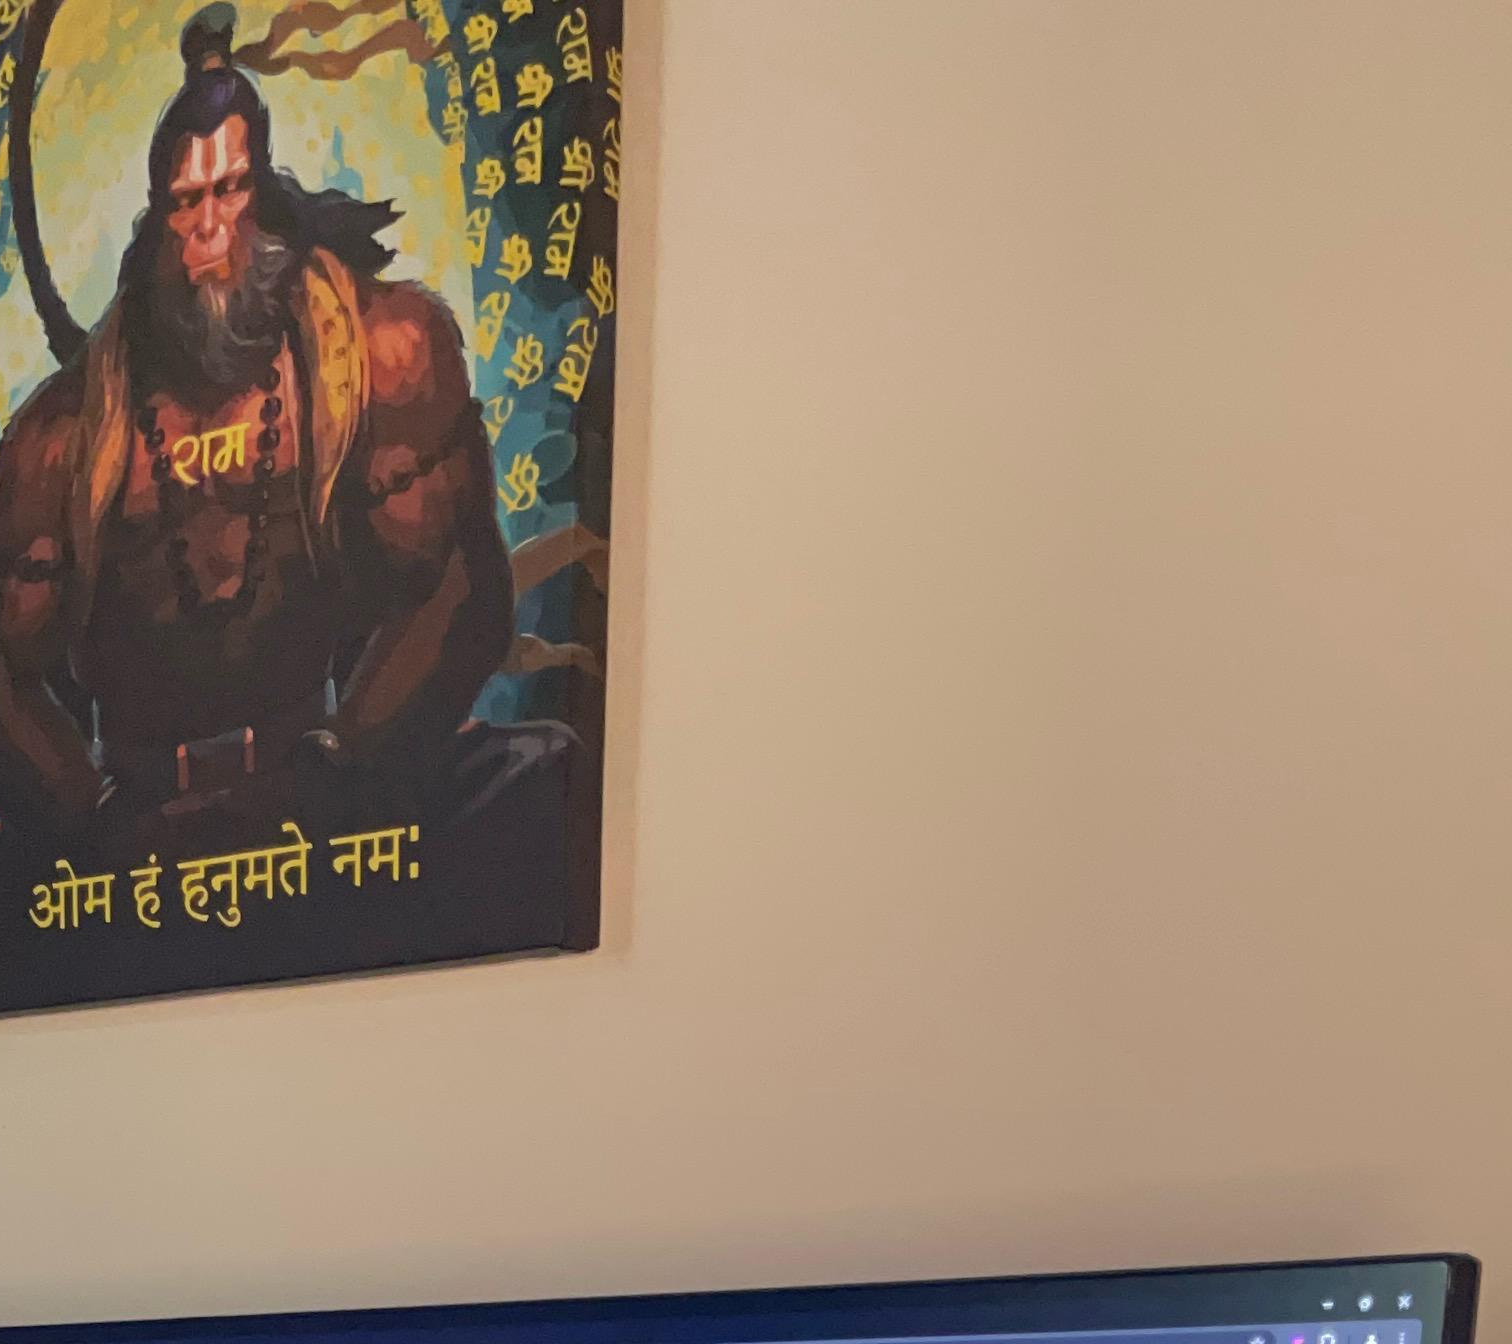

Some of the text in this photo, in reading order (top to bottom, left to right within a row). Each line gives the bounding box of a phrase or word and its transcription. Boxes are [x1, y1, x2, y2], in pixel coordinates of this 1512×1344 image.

[516, 63, 553, 109] श्री
[513, 116, 543, 184] राम
[504, 7, 594, 390] राम श्री राम श्री
[495, 233, 532, 284] श्री
[586, 256, 614, 318] श्री
[554, 317, 598, 402] राम
[172, 422, 251, 486] राम
[498, 453, 540, 515] श्री
[29, 860, 114, 929] ओम
[131, 854, 162, 928] हं
[177, 822, 311, 928] हनुमते
